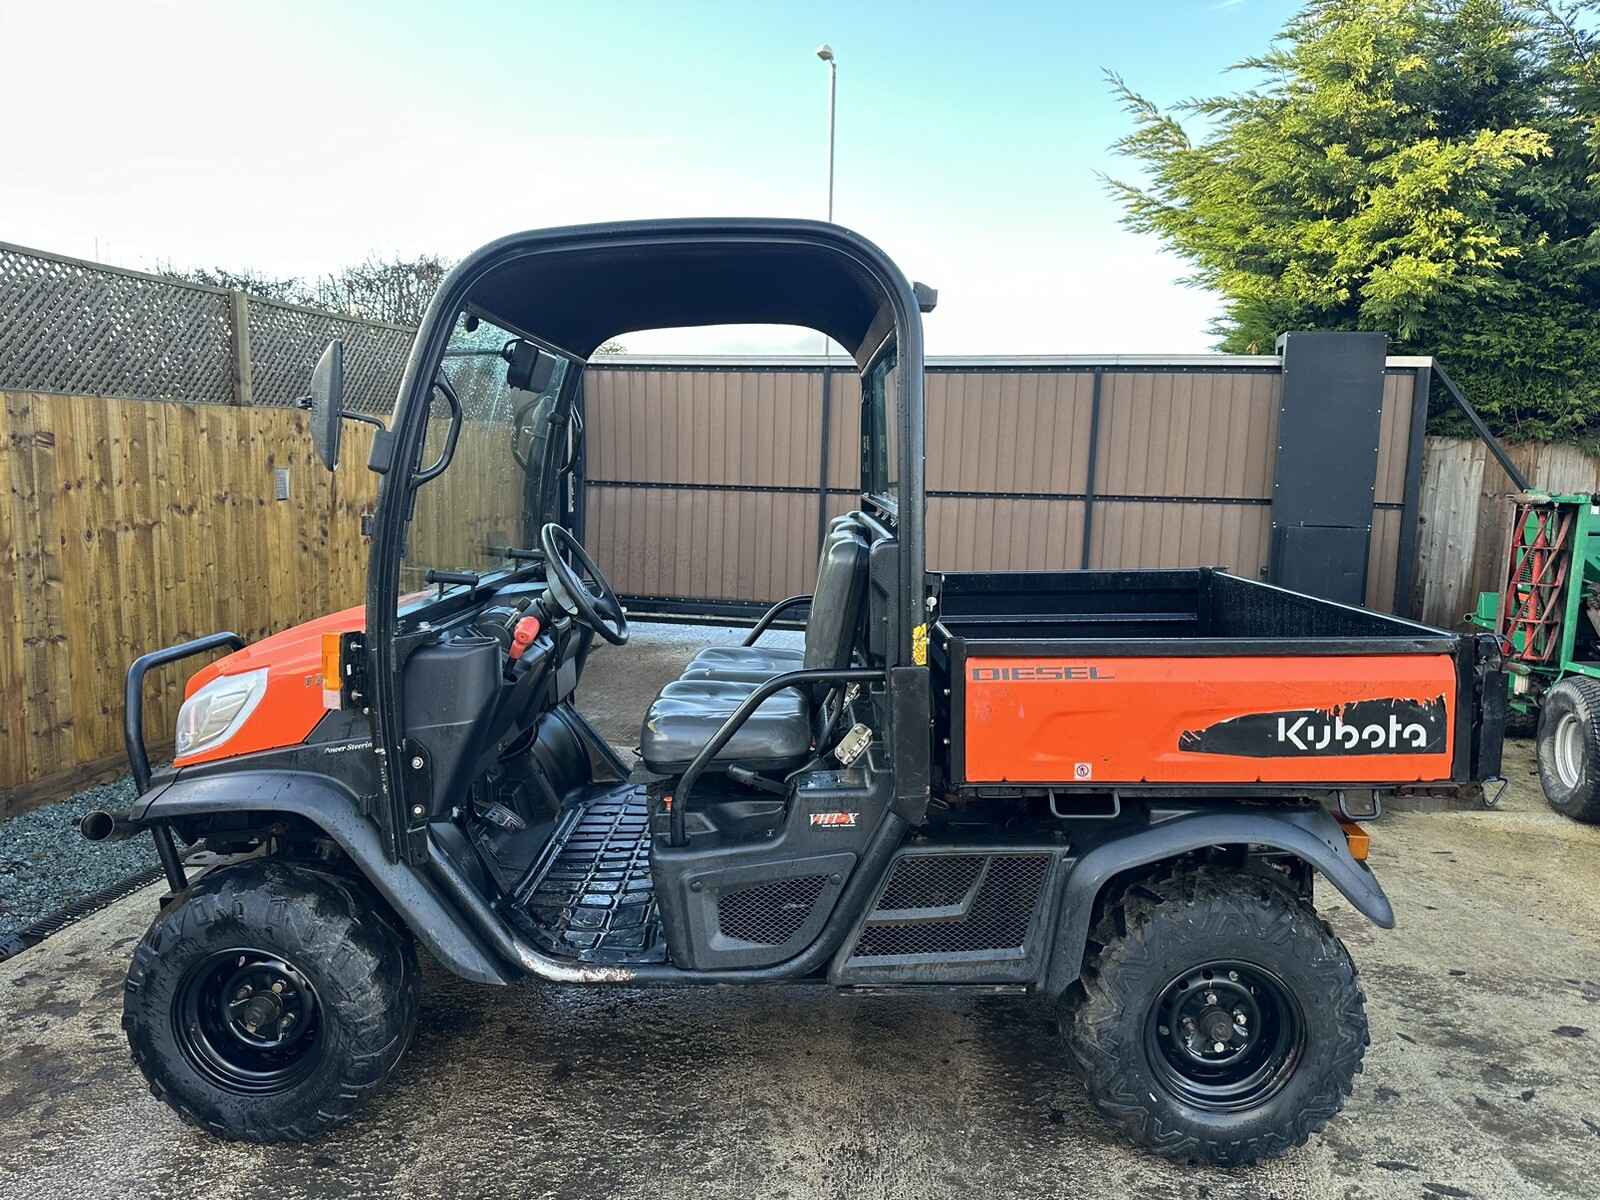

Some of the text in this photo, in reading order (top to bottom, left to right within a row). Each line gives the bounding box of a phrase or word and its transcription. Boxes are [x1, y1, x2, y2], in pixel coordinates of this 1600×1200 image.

[972, 667, 1115, 681] DIESEL
[1278, 714, 1427, 750] Kubota
[324, 741, 373, 754] Power Steerin
